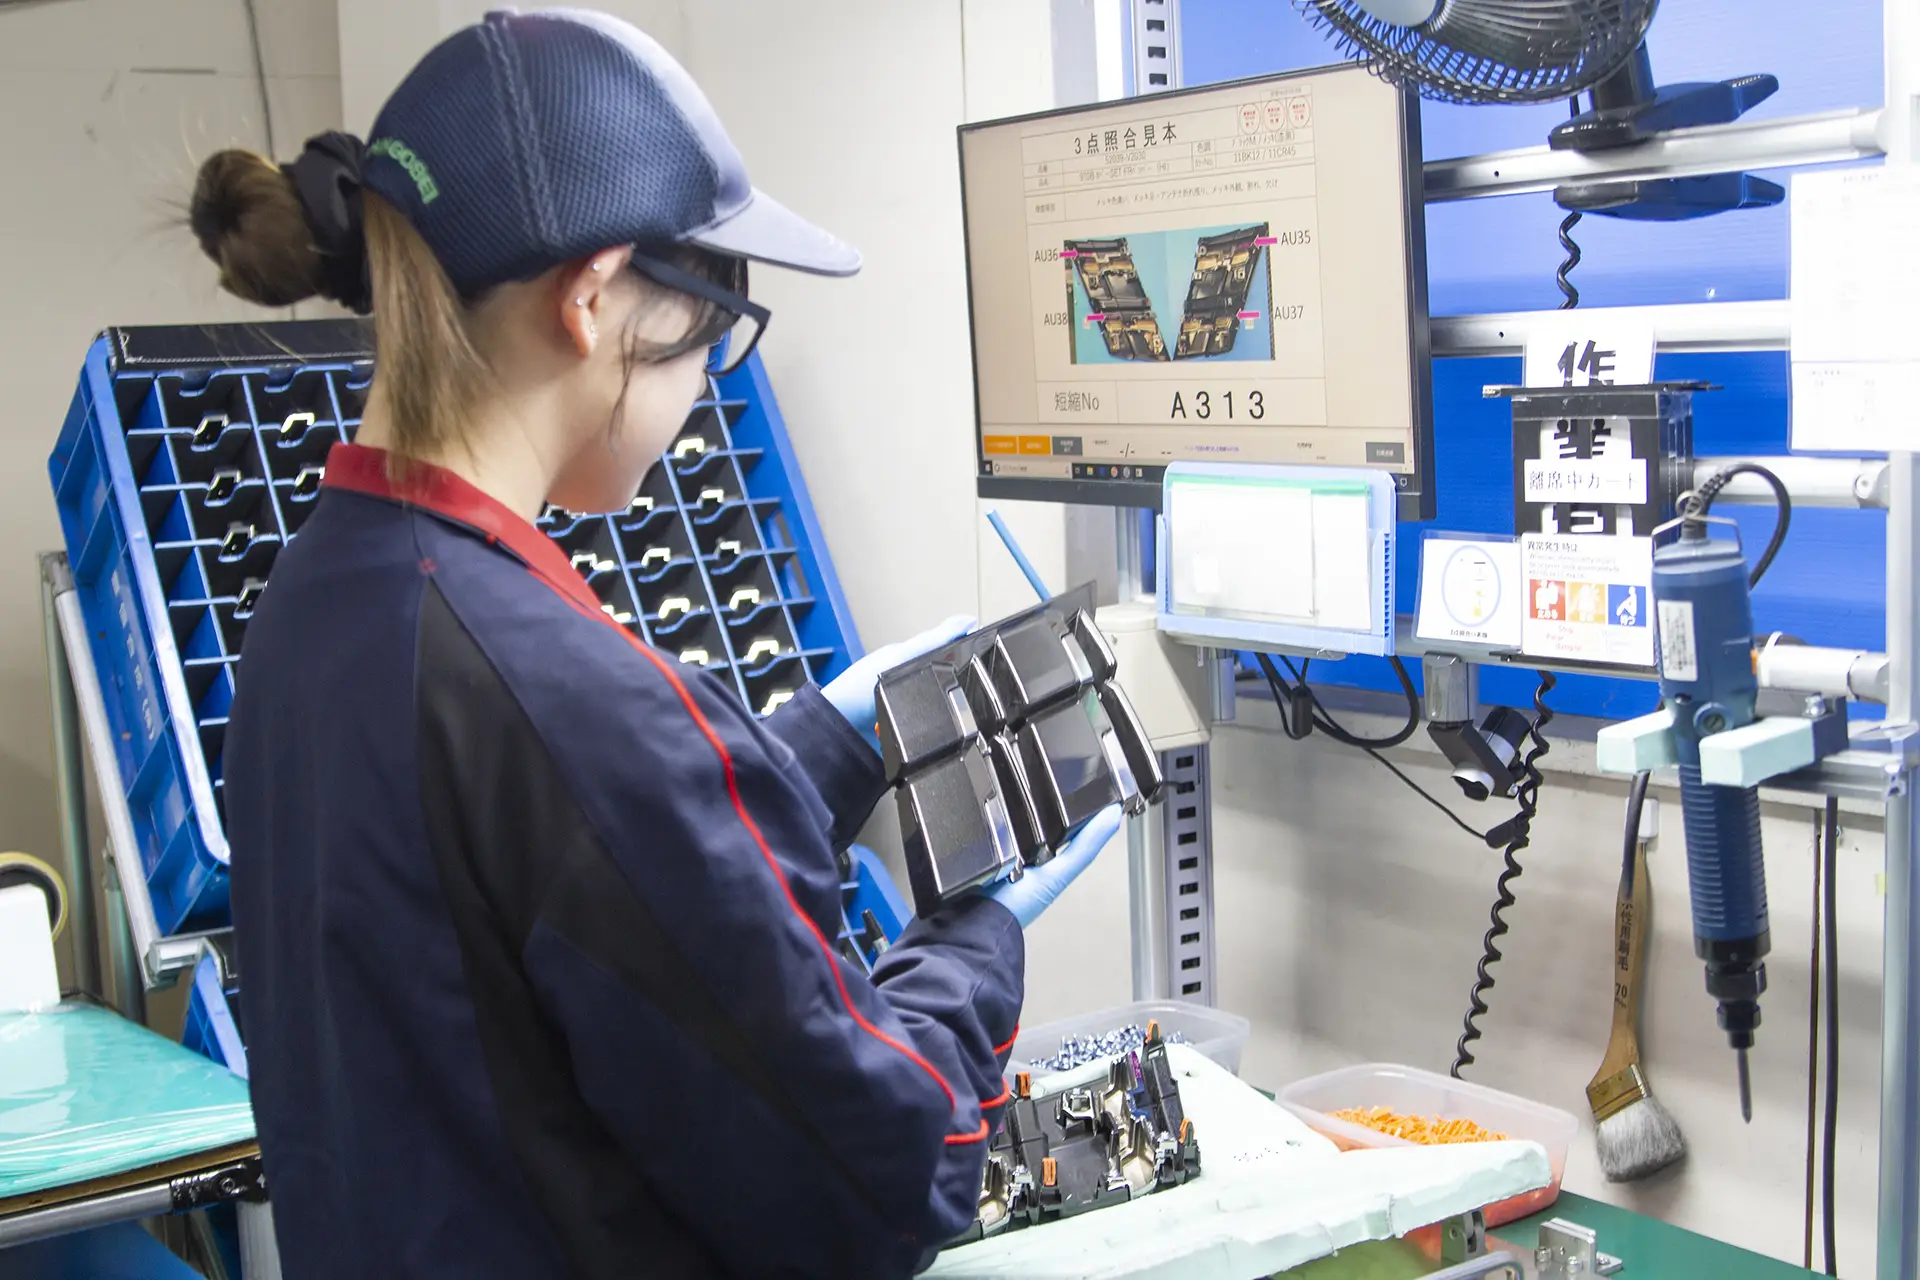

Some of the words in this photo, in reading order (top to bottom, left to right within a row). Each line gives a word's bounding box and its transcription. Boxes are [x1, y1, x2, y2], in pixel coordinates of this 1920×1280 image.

[1074, 121, 1177, 154] 3点照合見本
[1281, 230, 1311, 245] AU35
[1034, 248, 1058, 262] AU36
[1043, 312, 1068, 326] AU38
[1274, 305, 1304, 320] AU37
[1054, 392, 1100, 411] 短縮No
[1170, 391, 1265, 419] A313
[1615, 982, 1628, 998] 70
